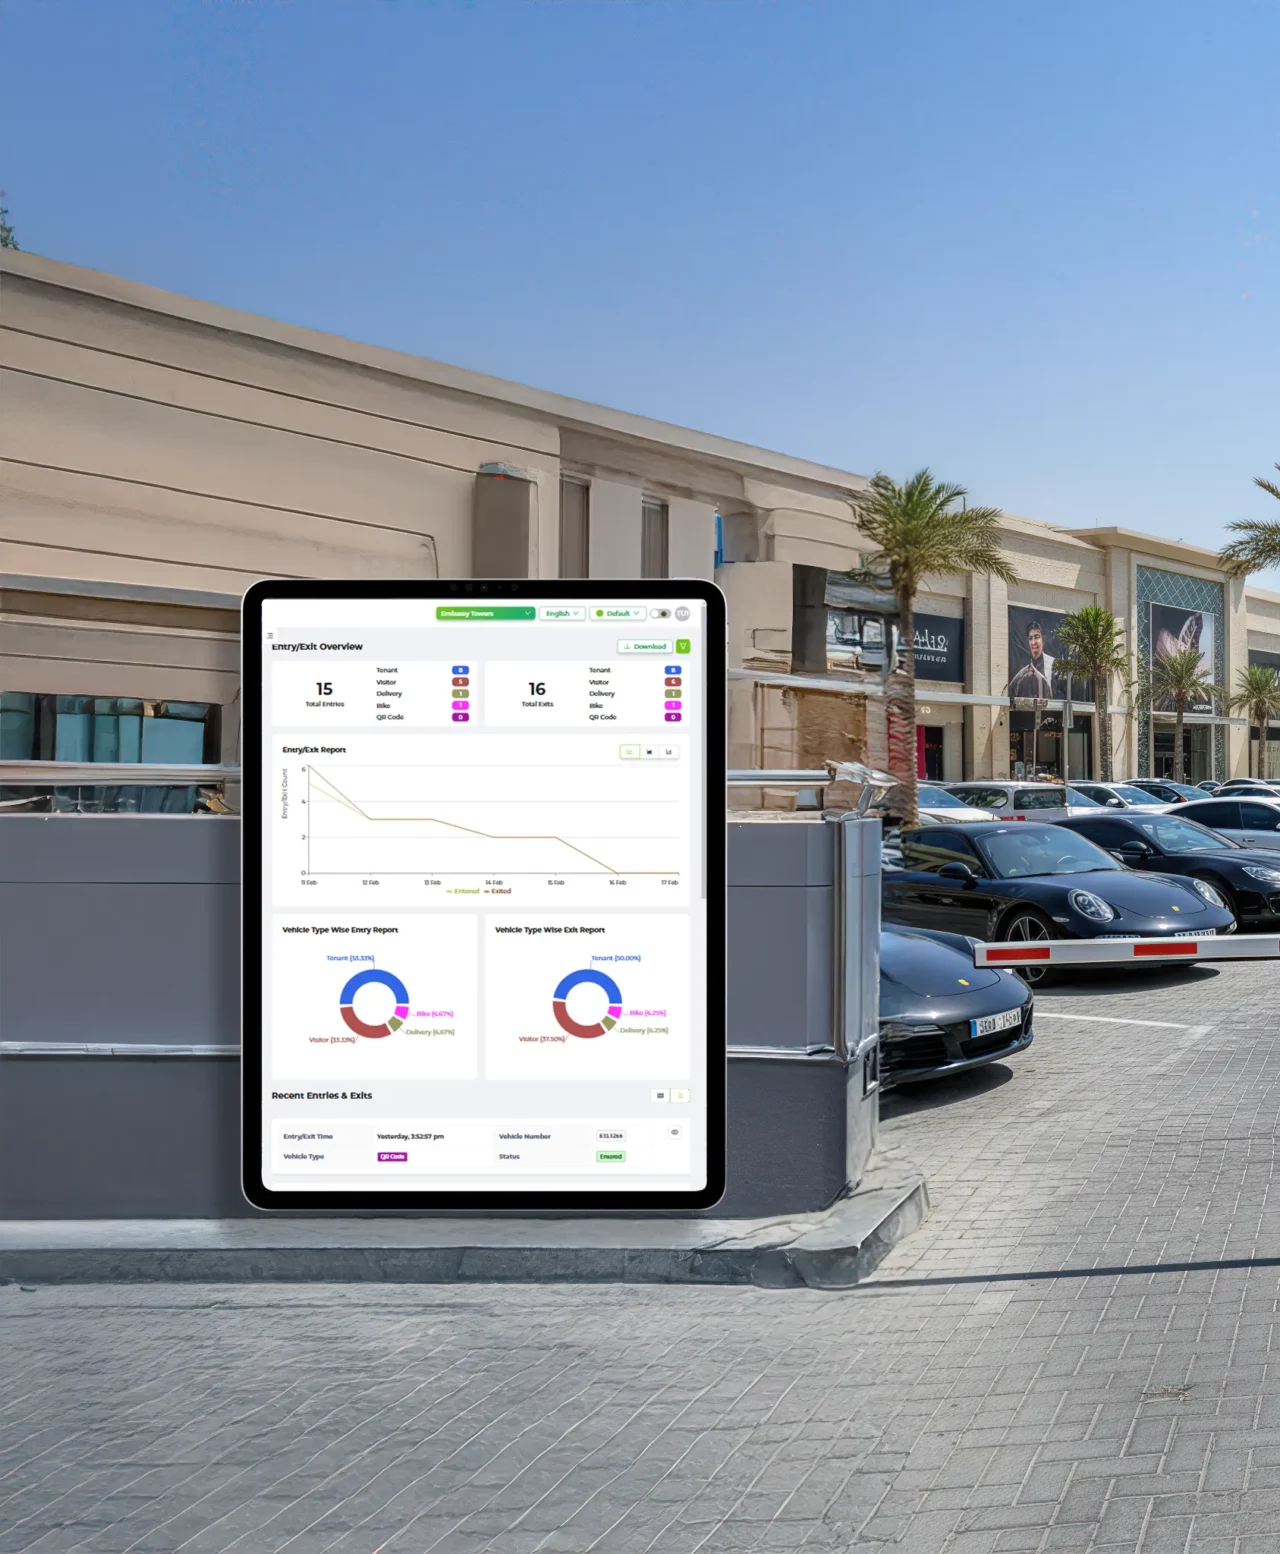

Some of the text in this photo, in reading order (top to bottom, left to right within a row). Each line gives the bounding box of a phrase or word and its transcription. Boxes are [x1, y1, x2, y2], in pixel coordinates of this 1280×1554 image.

[441, 610, 470, 618] Embassy
[272, 643, 363, 652] Entry/Exit Overview
[316, 682, 333, 696] 15
[529, 682, 546, 696] 16
[589, 690, 615, 698] Delivery
[282, 747, 347, 755] Entry/Exit Report
[309, 1153, 324, 1161] Type
